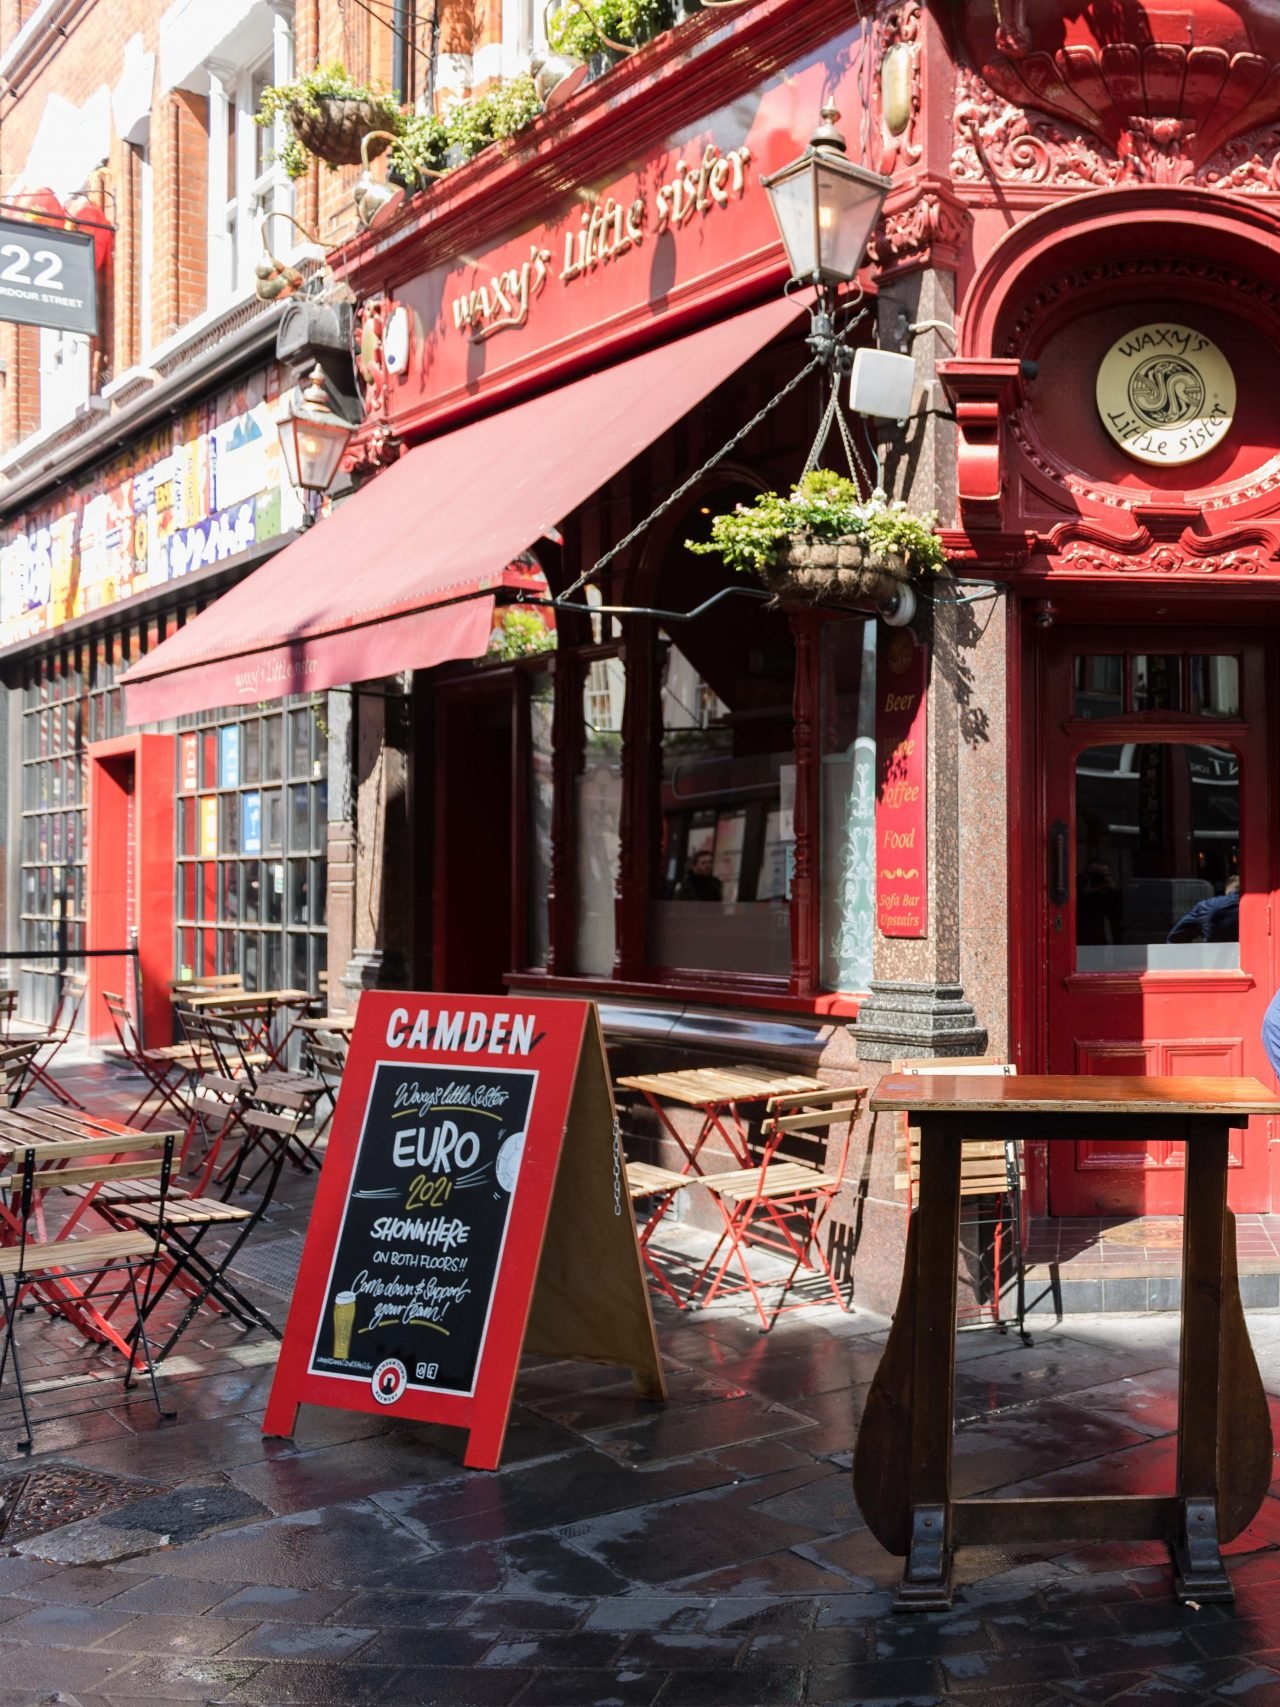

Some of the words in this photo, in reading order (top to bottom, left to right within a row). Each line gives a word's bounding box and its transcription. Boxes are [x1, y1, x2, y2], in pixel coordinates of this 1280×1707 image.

[0, 244, 64, 290] 22
[40, 293, 84, 309] STREET
[885, 693, 915, 712] Beer
[883, 827, 915, 849] Food
[879, 893, 900, 911] Sofa
[902, 894, 920, 907] Bar
[879, 912, 920, 930] Upstairs
[385, 1008, 536, 1056] CAMDEN
[392, 1120, 480, 1174] EURO
[405, 1174, 453, 1211] 2021
[373, 1250, 389, 1264] ON
[391, 1252, 418, 1268] BOTH
[420, 1254, 468, 1273] FLOORS!!
[368, 1301, 405, 1330] your
[402, 1298, 450, 1325] team!
